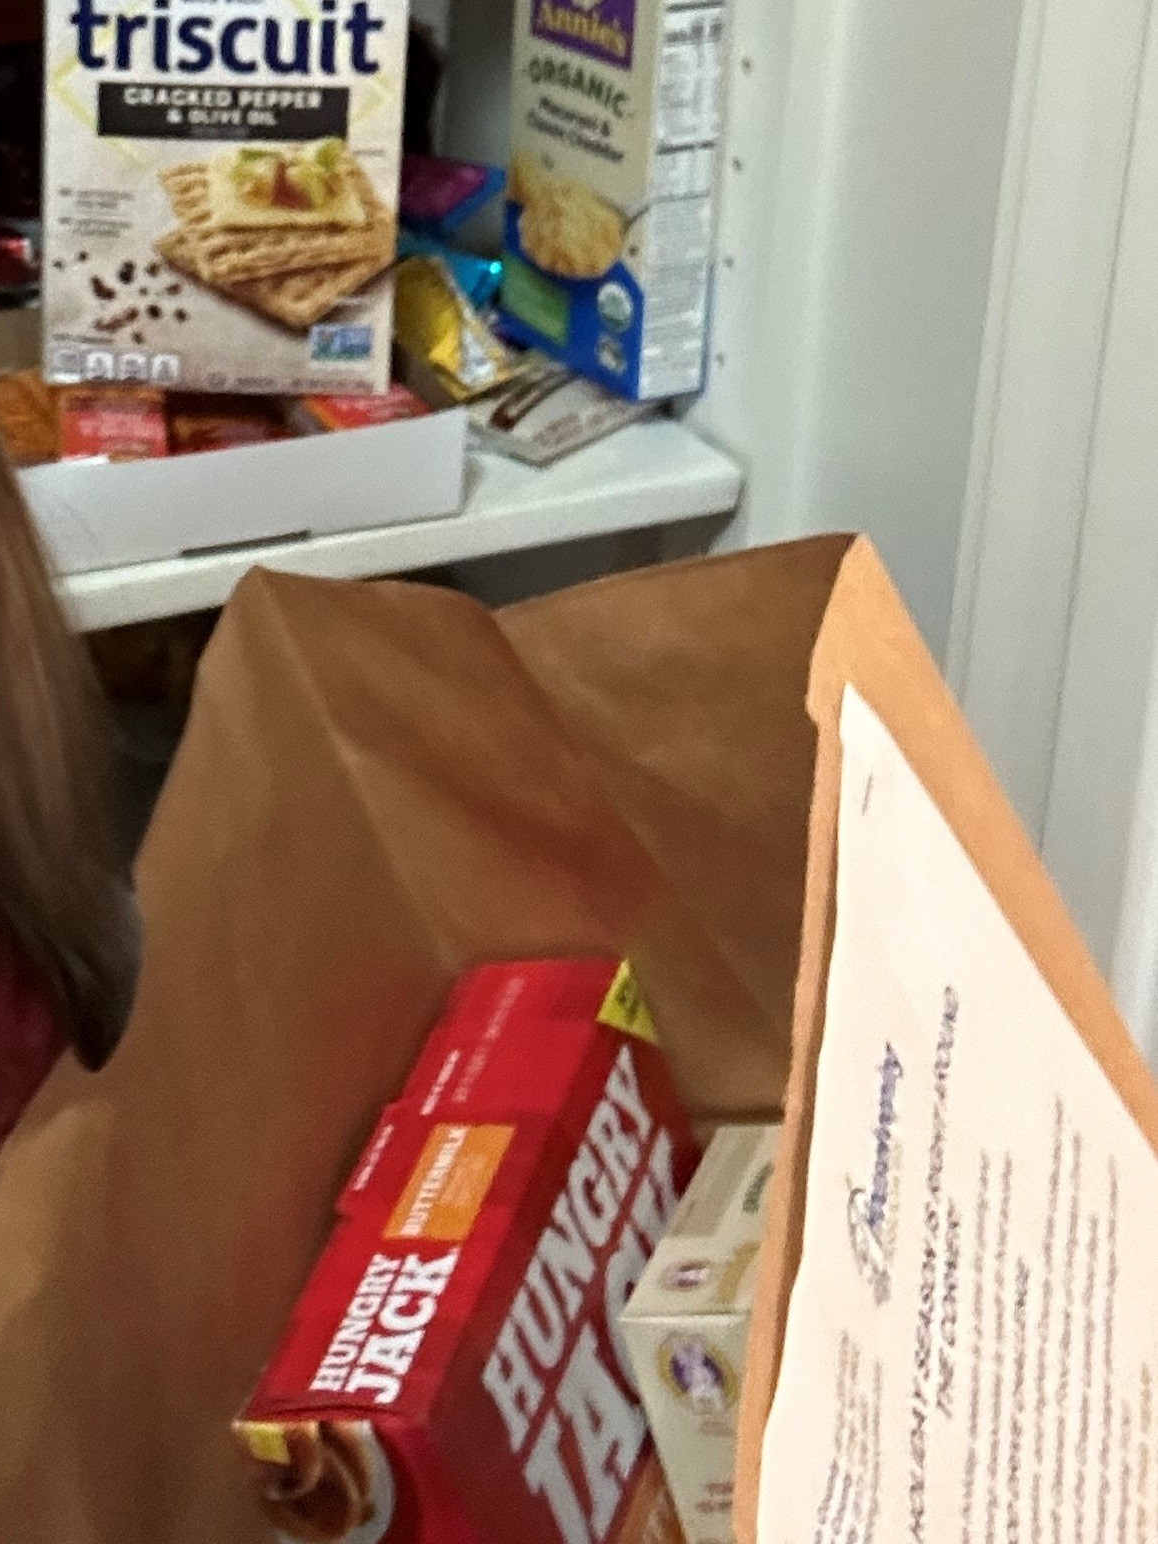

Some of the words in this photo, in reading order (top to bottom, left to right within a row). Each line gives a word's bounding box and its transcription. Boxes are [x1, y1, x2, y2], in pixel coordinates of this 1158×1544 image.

[123, 86, 232, 108] CRACKED
[238, 89, 323, 110] PEPPER
[188, 110, 242, 125] OLIVE
[528, 56, 628, 120] ORGANIC
[482, 1043, 653, 1456] HUNGRY
[308, 1253, 401, 1393] HUNGRY
[345, 1246, 463, 1406] JACK
